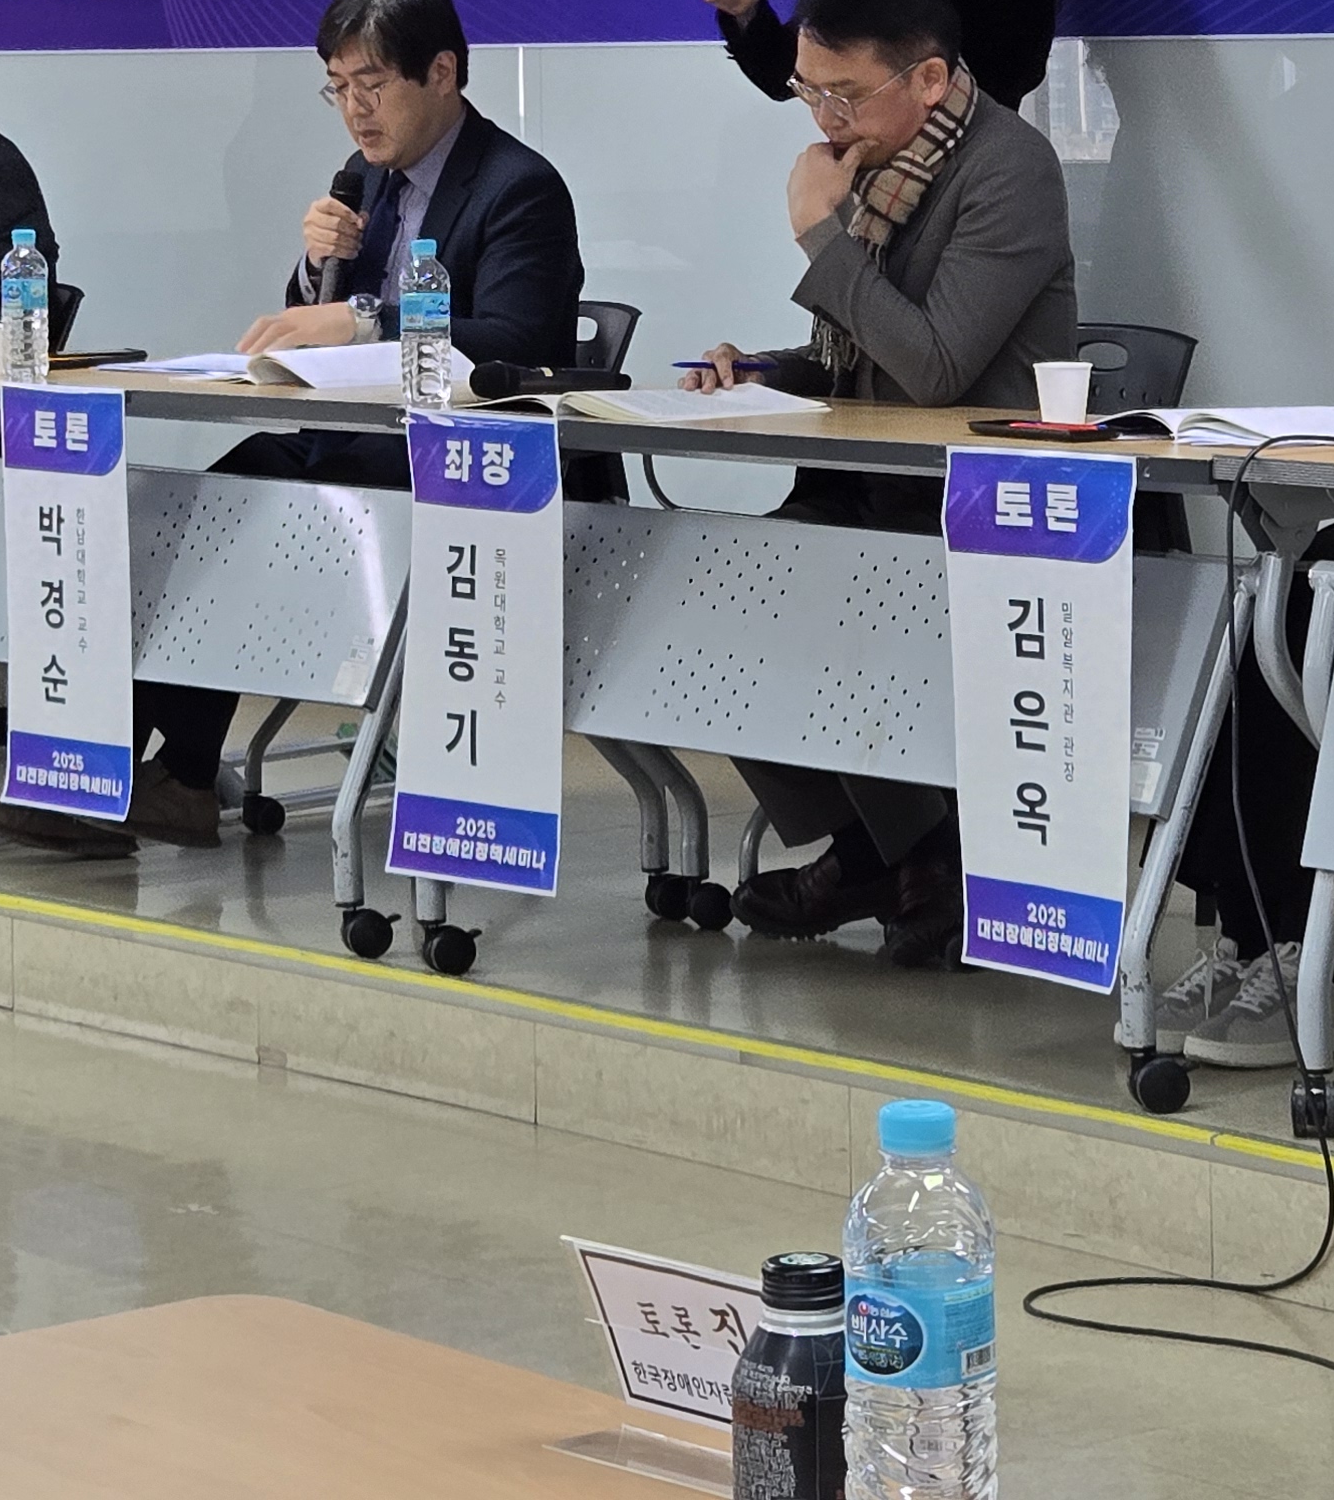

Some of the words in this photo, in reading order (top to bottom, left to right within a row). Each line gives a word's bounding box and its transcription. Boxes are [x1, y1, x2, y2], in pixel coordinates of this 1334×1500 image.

[33, 409, 89, 452] 토론
[444, 439, 515, 486] 좌장
[995, 481, 1079, 533] 토론
[39, 504, 68, 705] 박경순
[493, 548, 507, 656] 목원대학교
[77, 616, 88, 654] 교수
[444, 544, 479, 767] 김동기
[493, 668, 507, 710] 교수
[1007, 597, 1051, 846] 김은옥
[1063, 736, 1075, 783] 관장
[455, 816, 497, 841] 2025
[1026, 902, 1067, 929] 2025
[636, 1301, 702, 1350] 토론
[851, 1313, 909, 1349] 백산수
